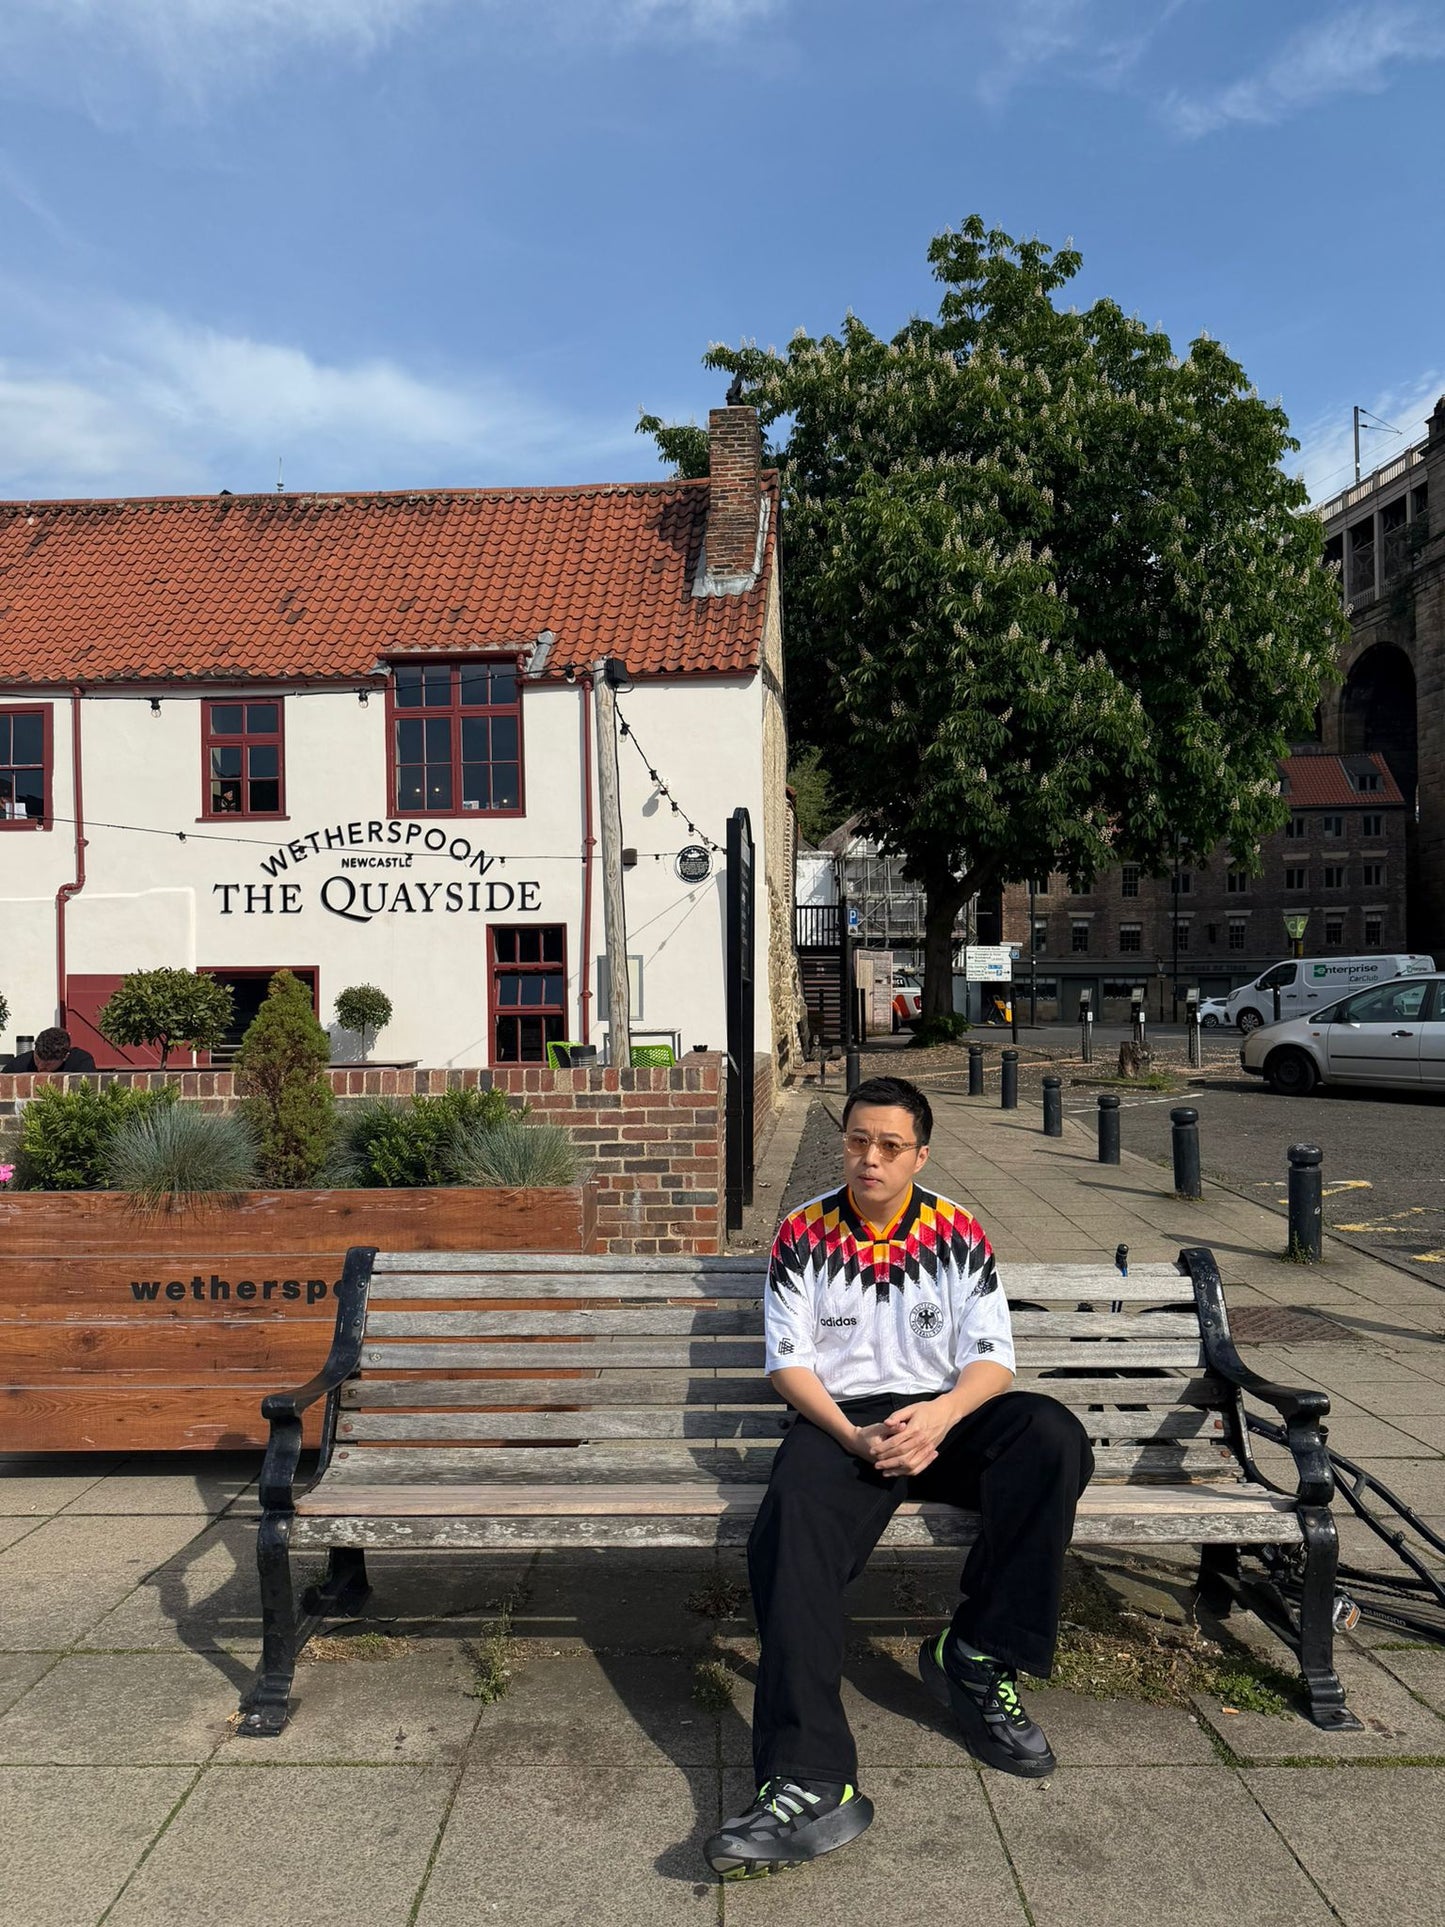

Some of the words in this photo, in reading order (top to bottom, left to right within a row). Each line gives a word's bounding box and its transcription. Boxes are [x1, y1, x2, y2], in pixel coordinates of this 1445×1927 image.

[260, 821, 495, 878] WETHERSPOON
[213, 883, 303, 914] THE
[321, 876, 541, 923] QUAYSIDE
[1314, 964, 1378, 976] enterprise
[820, 1316, 857, 1327] adidas
